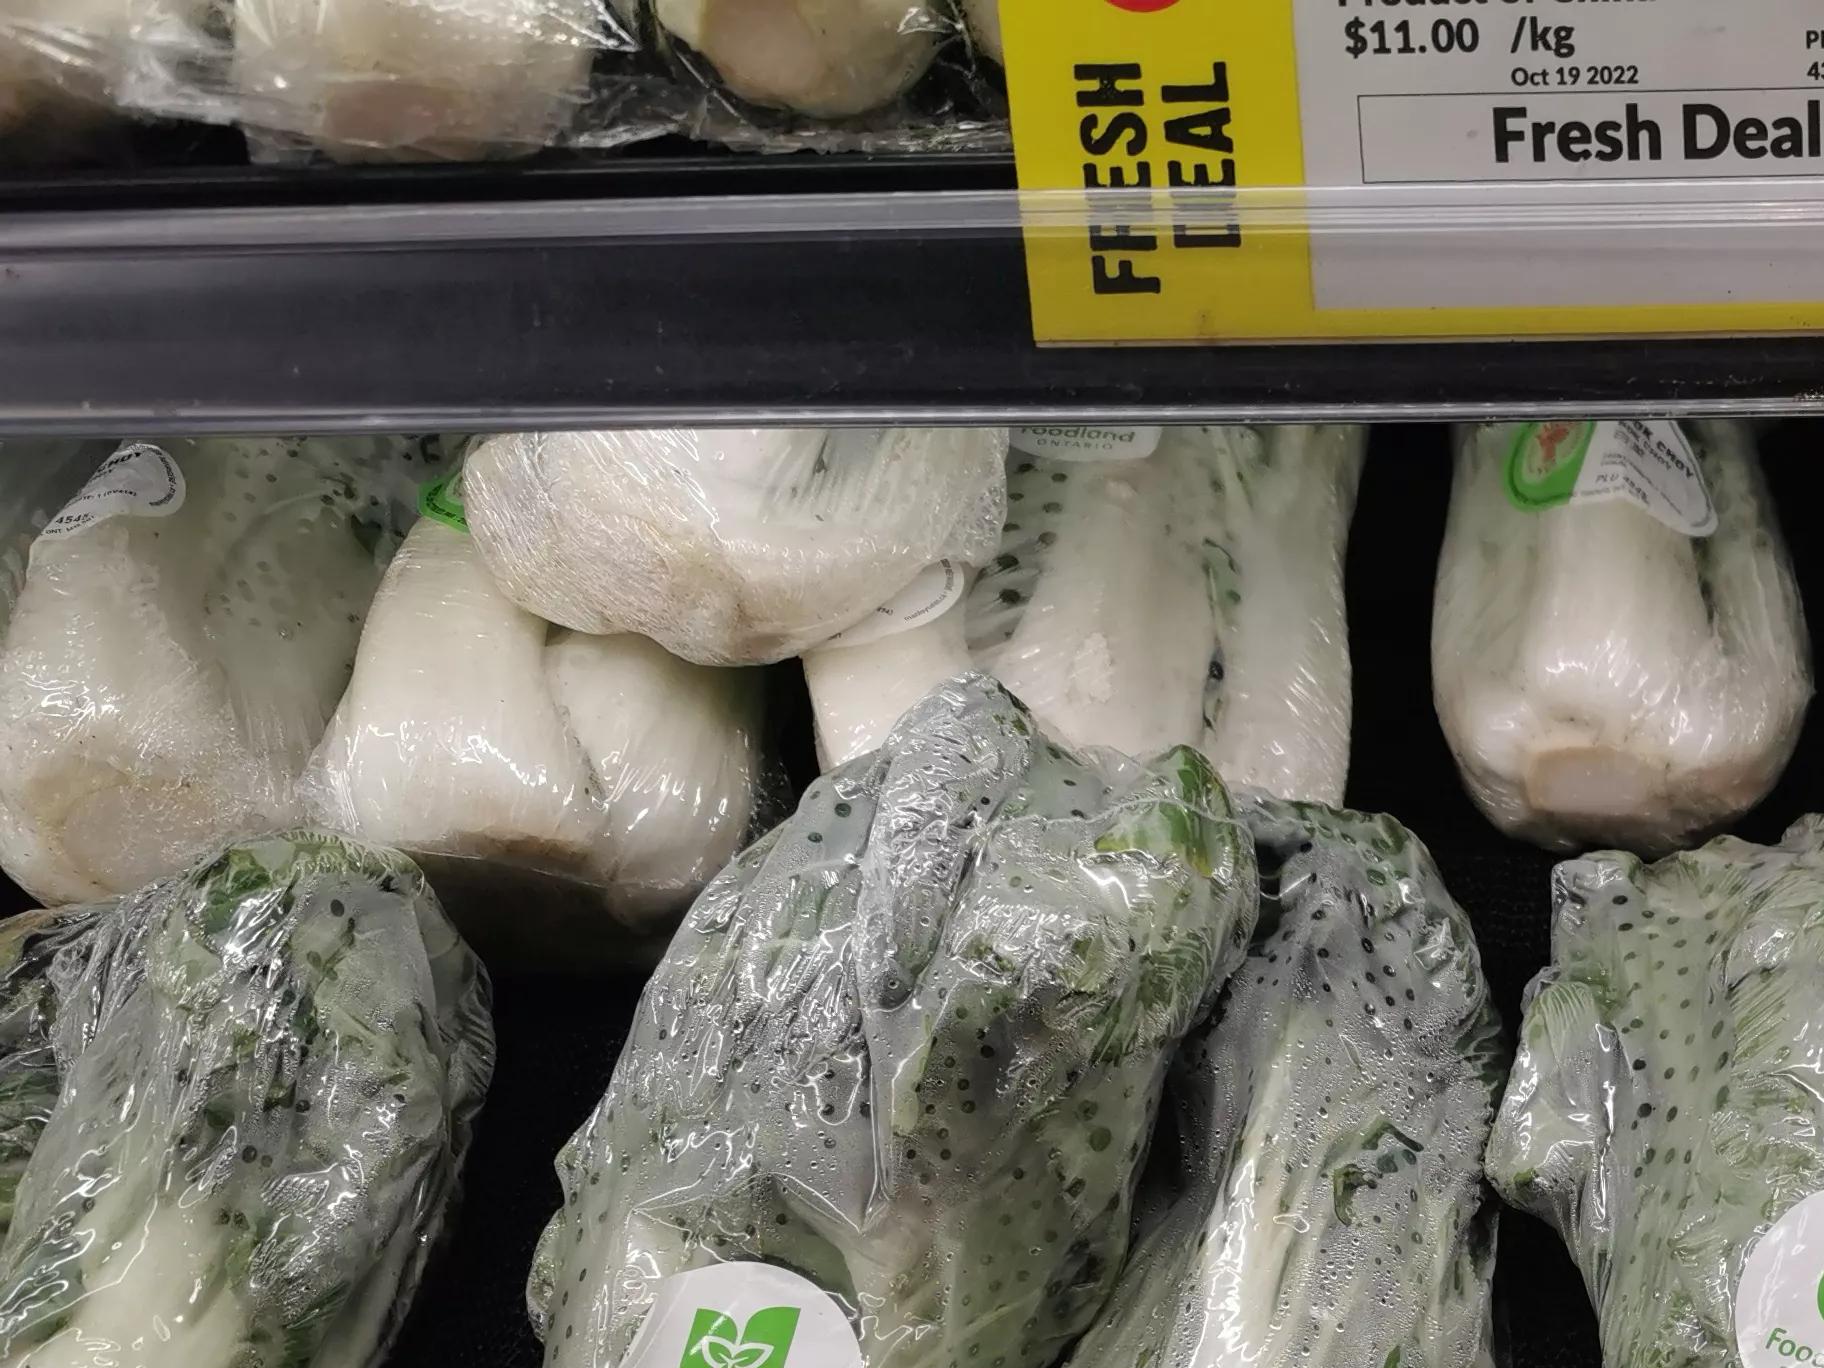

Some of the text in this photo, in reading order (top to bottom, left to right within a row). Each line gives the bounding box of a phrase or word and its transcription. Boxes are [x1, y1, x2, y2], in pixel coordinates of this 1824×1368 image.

[1345, 16, 1575, 59] $11.00 /kg
[1511, 65, 1639, 86] Oct 19 2022
[1492, 99, 1821, 164] Fresh Deal
